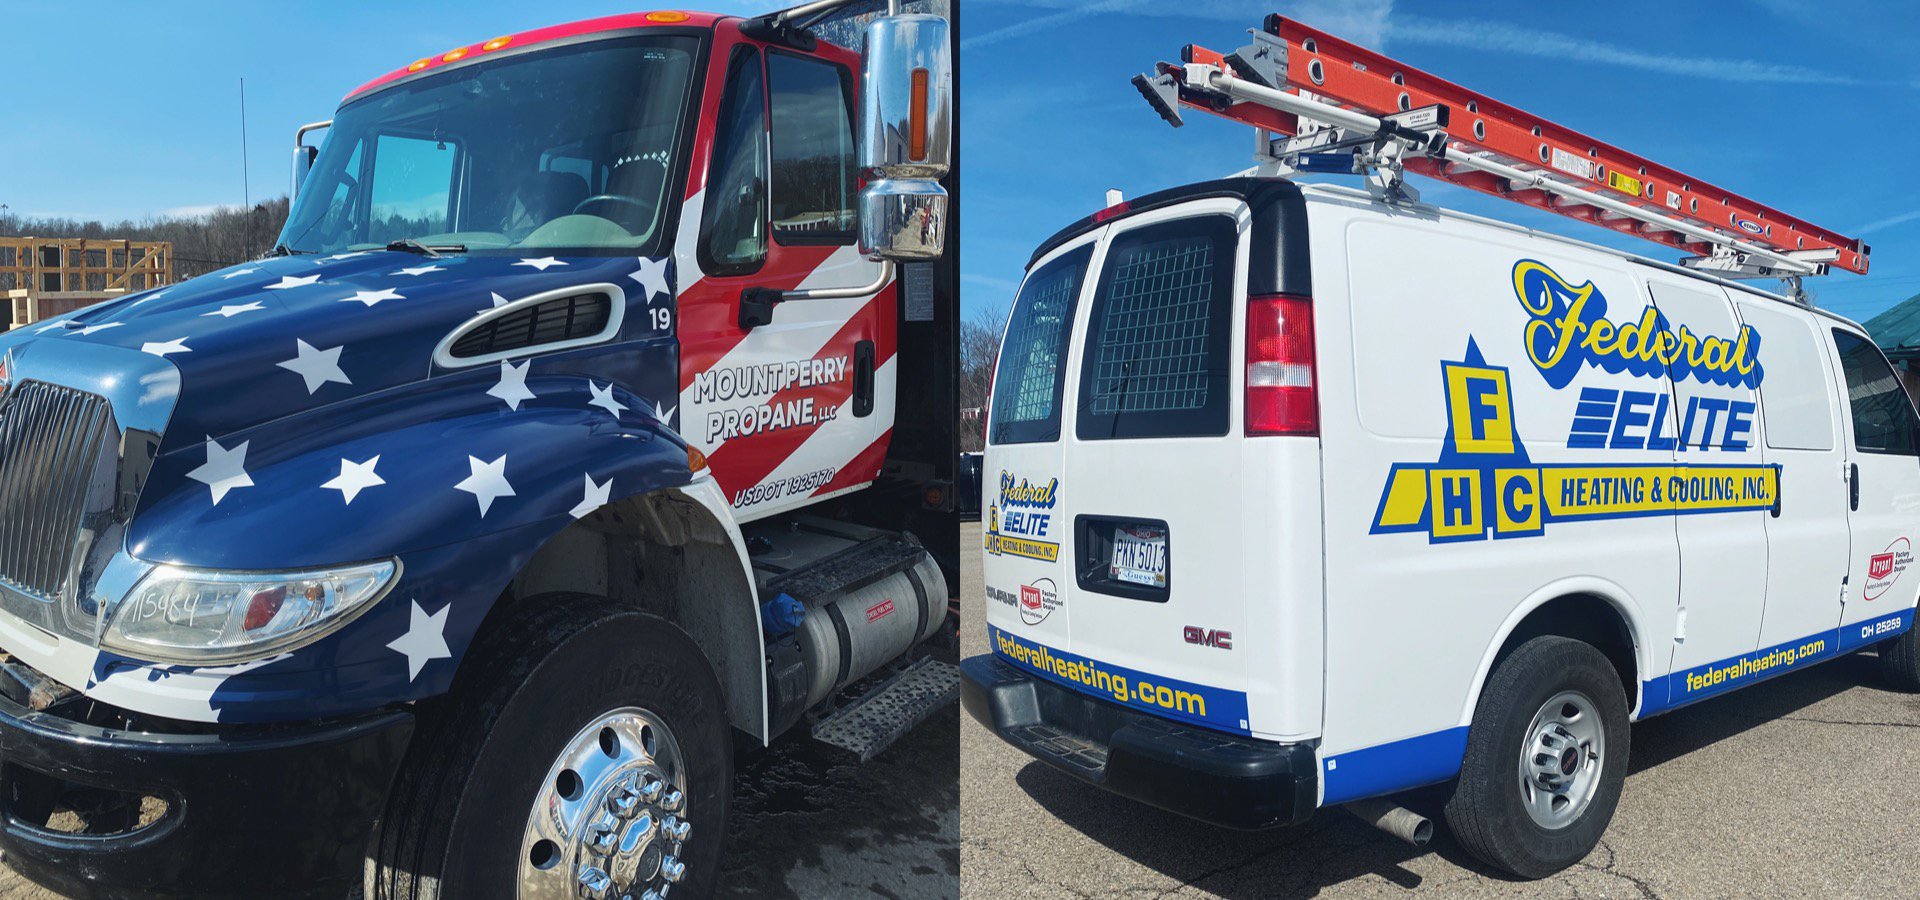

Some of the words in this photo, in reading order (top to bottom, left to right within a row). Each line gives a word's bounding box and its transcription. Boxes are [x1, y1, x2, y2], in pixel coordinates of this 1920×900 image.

[649, 308, 671, 330] 19
[1512, 258, 1764, 389] Federal
[694, 362, 783, 404] MOUNT
[785, 356, 848, 390] PERRY
[706, 397, 817, 444] PROPANE,
[818, 404, 838, 421] LLC
[1466, 377, 1499, 441] F
[1609, 390, 1756, 452] ELITE
[733, 480, 785, 508] USDOT
[786, 468, 836, 495] 1925170
[1000, 469, 1058, 512] Federal
[1442, 477, 1472, 526] H
[1503, 475, 1533, 523] C
[1560, 478, 1644, 507] HEATING
[1650, 478, 1664, 501] &
[1668, 476, 1739, 503] COOLING,
[1742, 476, 1770, 501] INC.
[1011, 511, 1050, 536] ELITE
[1136, 530, 1150, 538] OHIO
[1115, 538, 1136, 568] PKN
[1138, 541, 1165, 572] 5013
[1873, 557, 1891, 574] bryant
[1896, 551, 1909, 559] Factory
[1023, 588, 1039, 604] bryant
[1042, 589, 1056, 599] Factory
[1042, 597, 1063, 606] Authorized
[1043, 603, 1055, 611] Dealer
[1183, 625, 1232, 650] GMC
[1861, 624, 1874, 639] OH
[1876, 616, 1902, 634] 25259
[996, 629, 1206, 716] federalheating.com
[1687, 639, 1825, 692] federalheating.com
